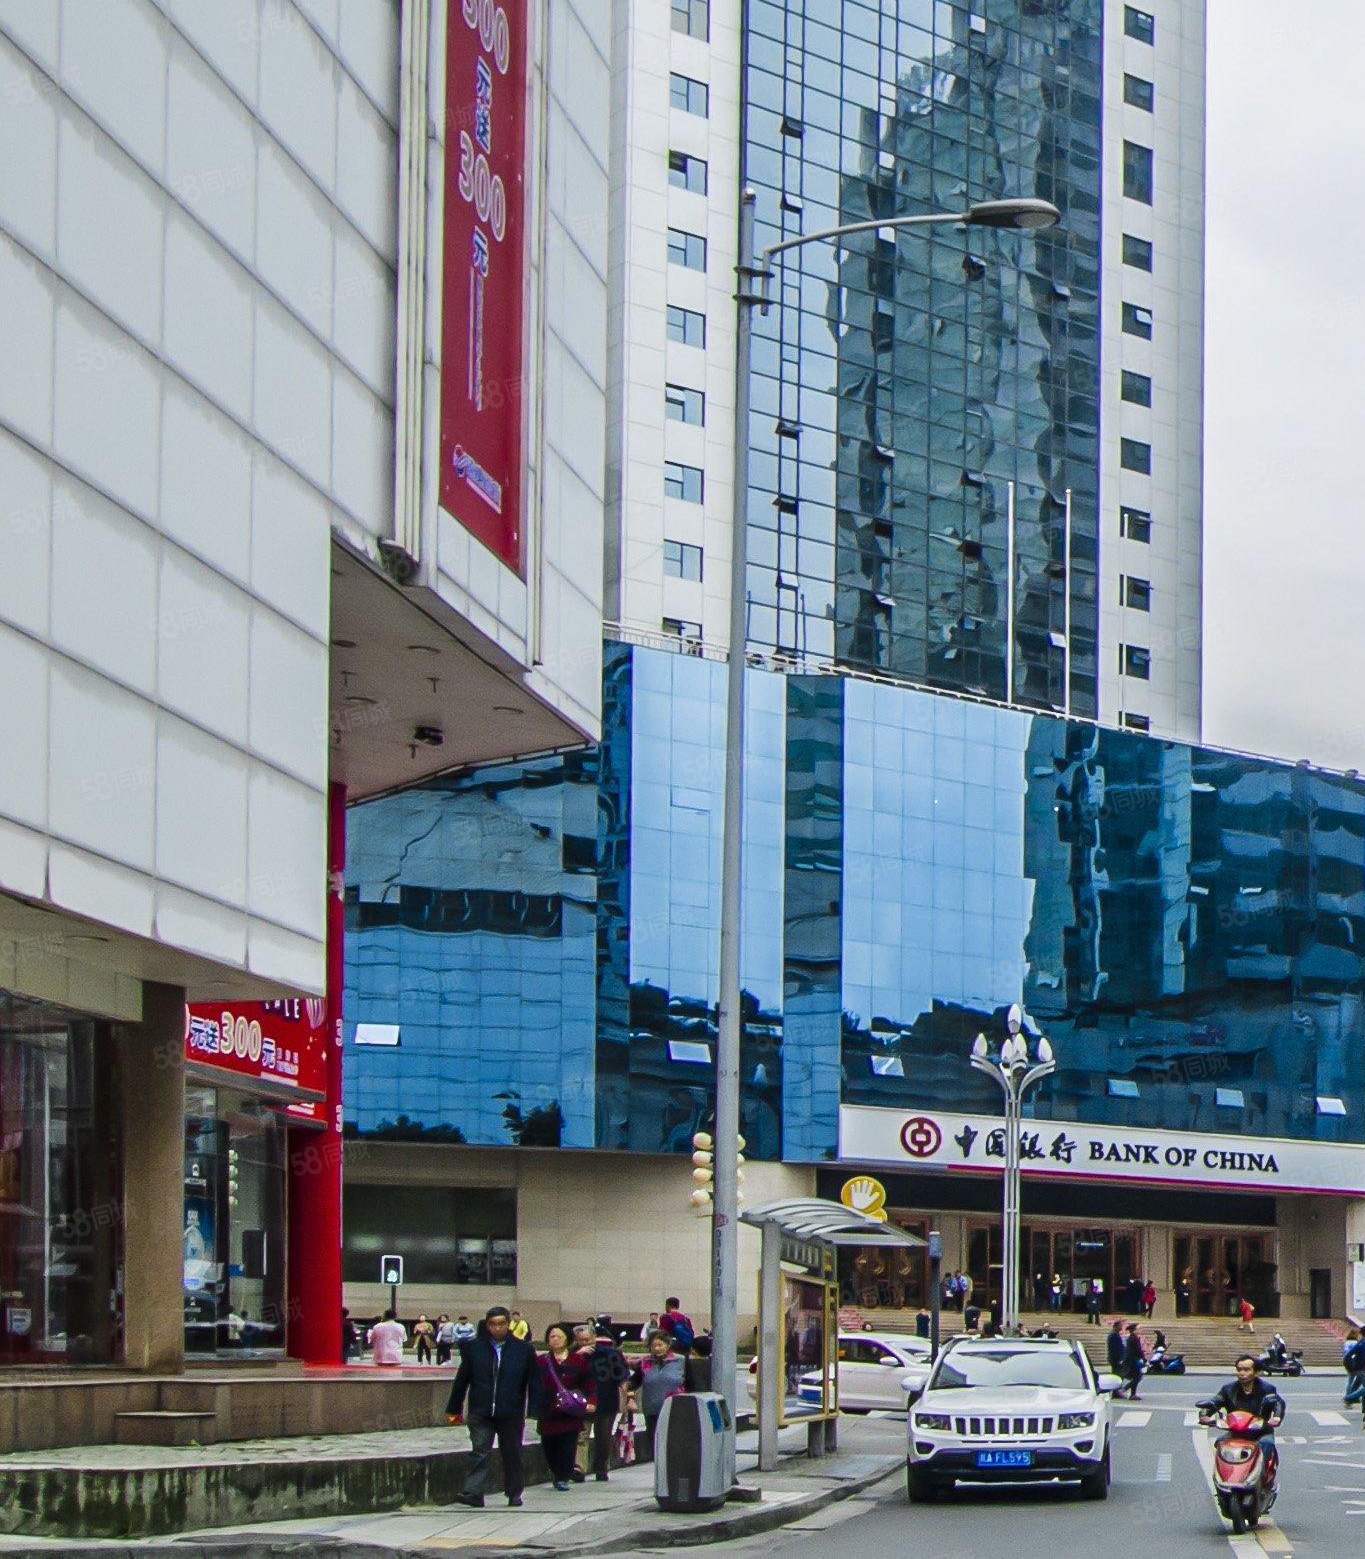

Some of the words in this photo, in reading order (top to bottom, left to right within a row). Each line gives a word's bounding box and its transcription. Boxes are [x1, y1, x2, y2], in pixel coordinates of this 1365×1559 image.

[954, 1124, 1077, 1164] 中国银行
[1088, 1141, 1160, 1165] BANK
[1164, 1147, 1197, 1167] OF
[1203, 1149, 1280, 1173] CHINA
